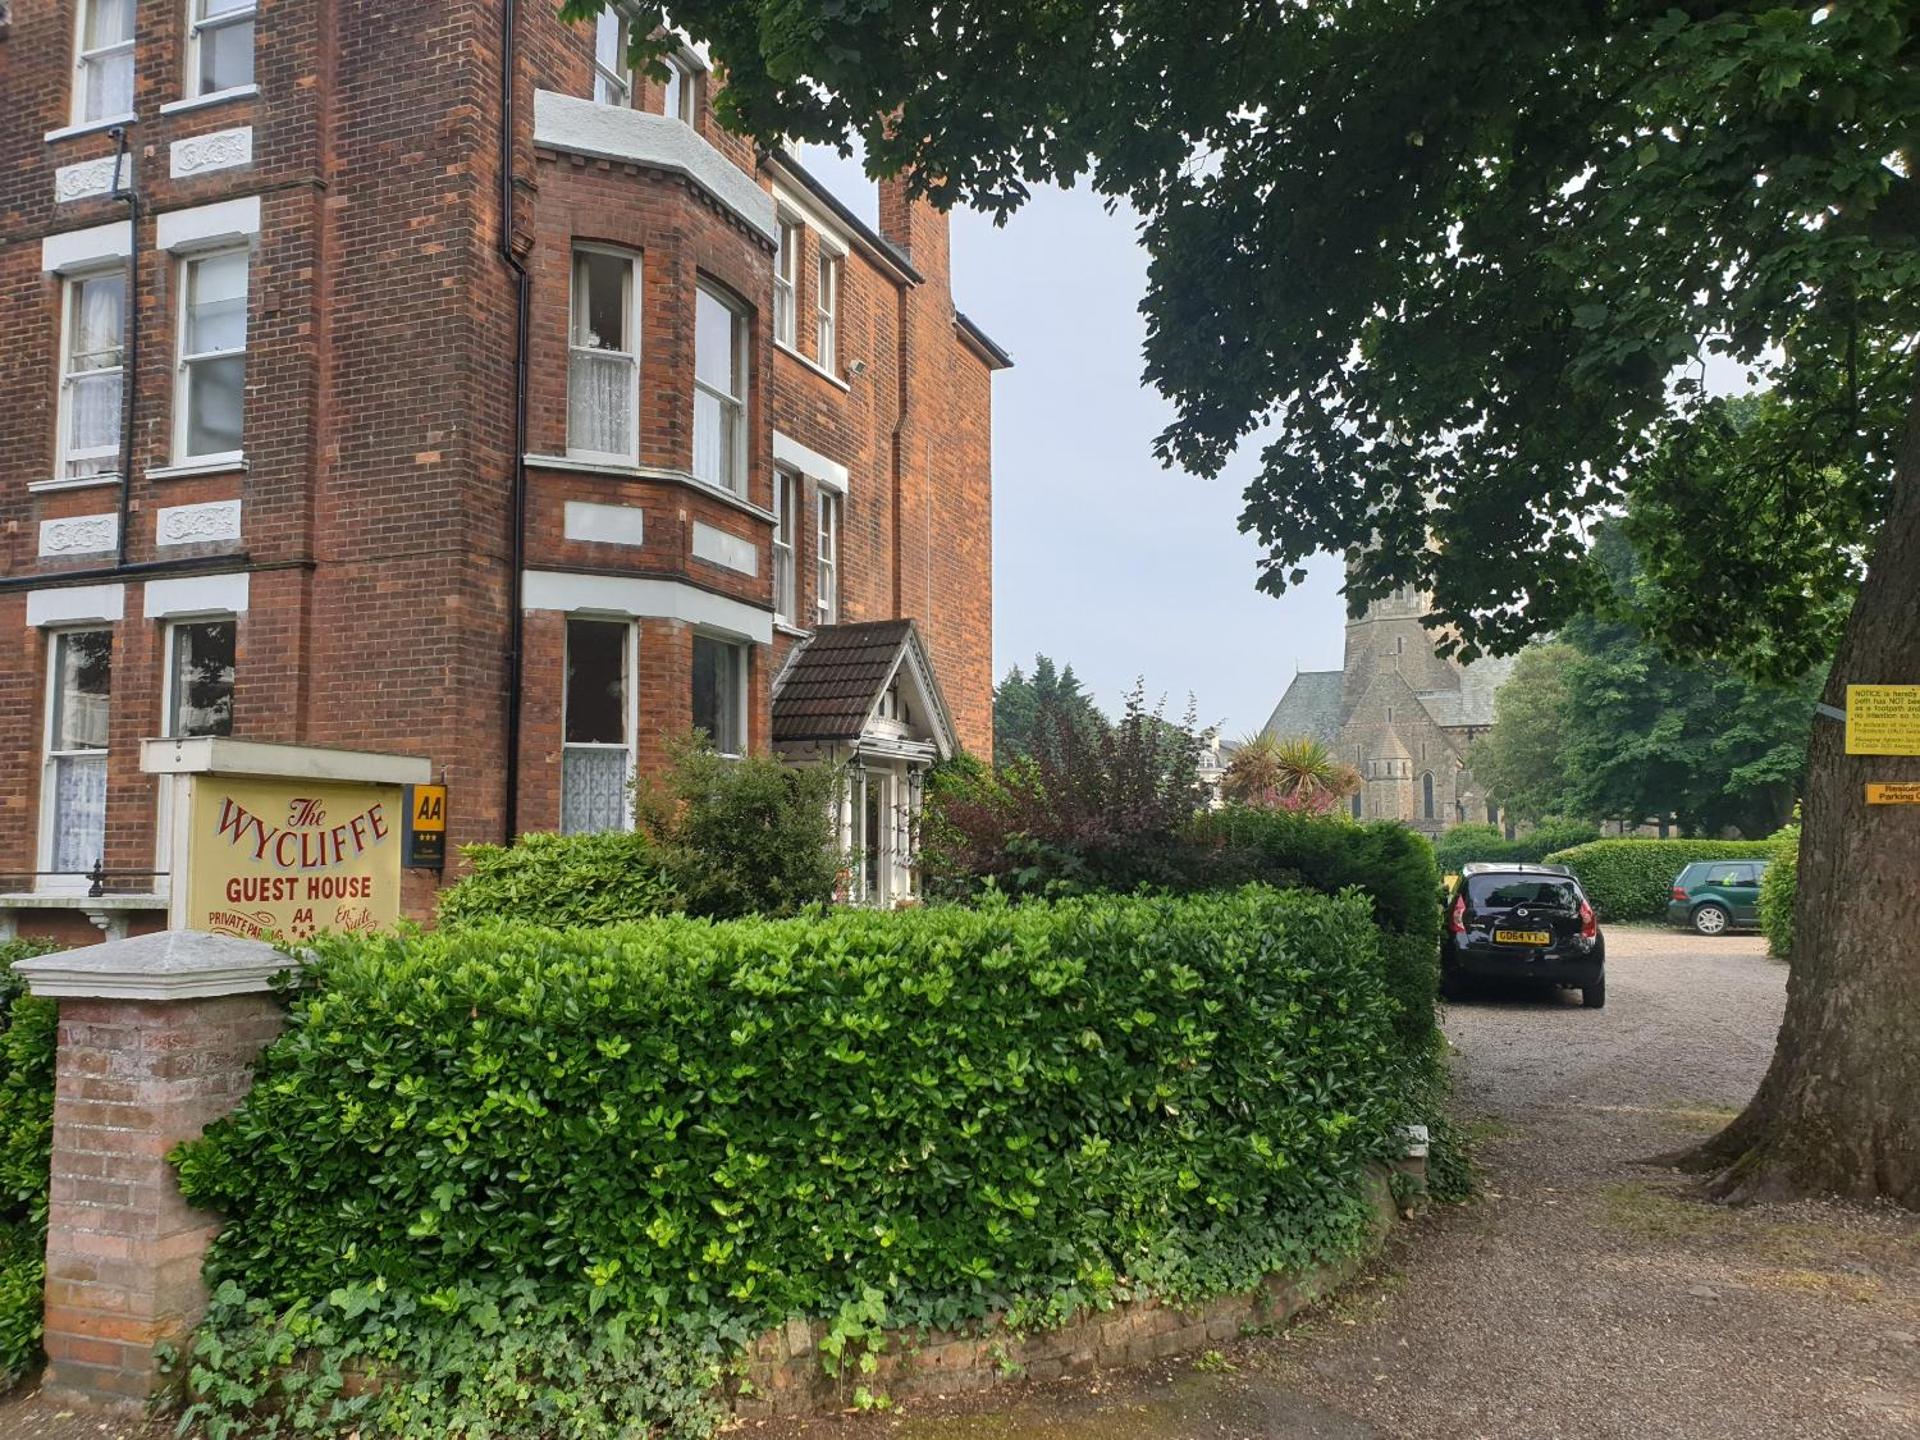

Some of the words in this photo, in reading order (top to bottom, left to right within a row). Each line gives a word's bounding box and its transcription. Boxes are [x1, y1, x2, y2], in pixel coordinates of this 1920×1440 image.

[417, 796, 442, 820] AA
[1879, 792, 1914, 800] Parking
[287, 798, 327, 828] The
[218, 796, 389, 868] WYCLIFFE
[226, 877, 299, 903] GUEST
[307, 876, 371, 900] HOUSE
[209, 911, 246, 932] PRIVATE
[246, 923, 284, 941] PARNG
[292, 907, 313, 923] AA
